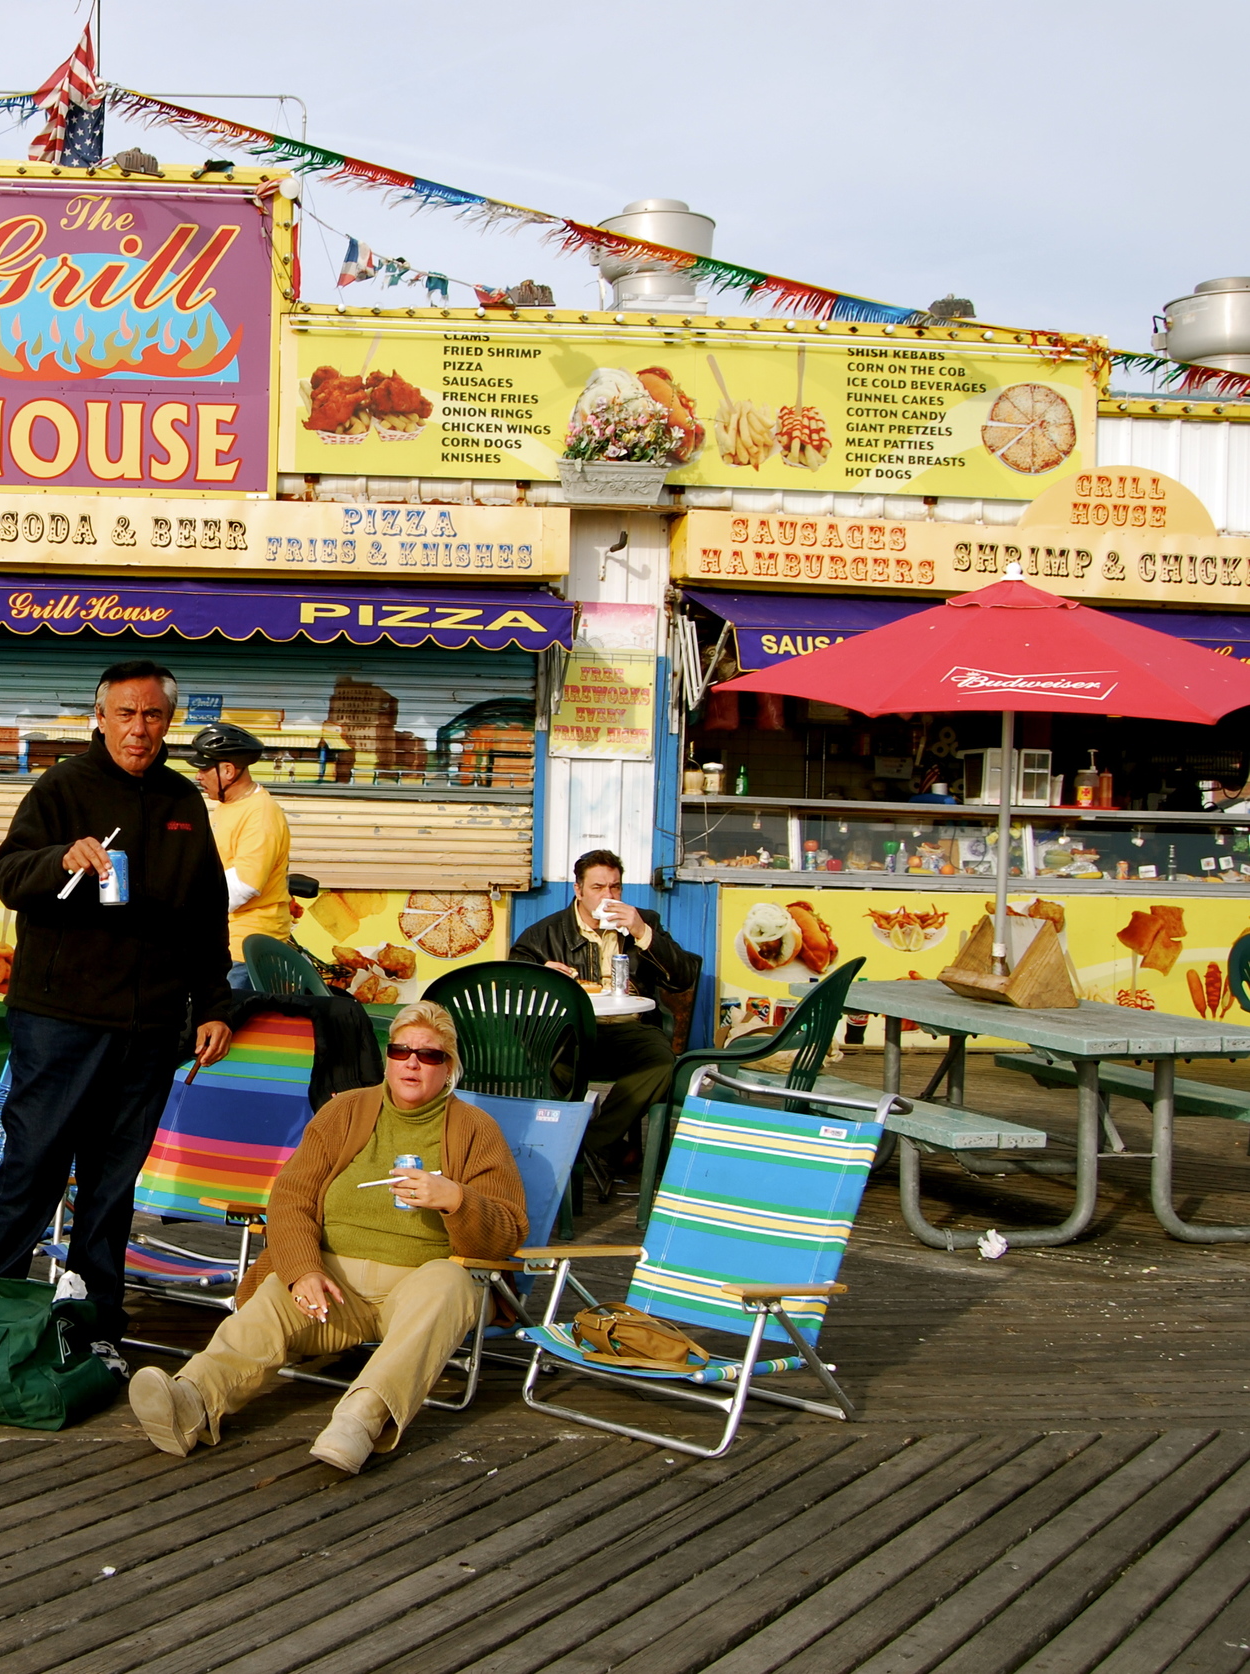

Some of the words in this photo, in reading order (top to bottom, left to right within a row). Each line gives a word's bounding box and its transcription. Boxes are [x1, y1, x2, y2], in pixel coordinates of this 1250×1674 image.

[59, 194, 135, 232] The
[443, 330, 490, 341] CLAMS
[443, 345, 484, 356] FRIED
[487, 347, 542, 359] SHRIMP
[847, 347, 889, 358] SHISH
[893, 349, 945, 361] KEBABS
[443, 361, 483, 372] PIZZA
[847, 362, 884, 373] CORN
[888, 364, 907, 374] ON
[910, 365, 936, 376] THE
[938, 366, 966, 378] COB
[442, 376, 514, 388] SAUSAGES
[847, 377, 868, 388] ICE
[871, 378, 907, 390] COLD
[910, 380, 987, 394] BEVERAGES
[442, 391, 496, 404] FRENCH
[500, 393, 539, 405] FRIES
[846, 392, 899, 405] FUNNEL
[901, 394, 945, 407] CAKES
[442, 406, 487, 418] ONION
[490, 408, 533, 420] RINGS
[846, 407, 898, 419] COTTON
[901, 409, 947, 423] CANDY
[442, 421, 504, 434] CHICKEN
[506, 423, 551, 436] WINGS
[846, 422, 885, 434] GIANT
[888, 424, 953, 437] PRETZELS
[441, 437, 481, 448] CORN
[484, 438, 522, 449] DOGS
[845, 437, 880, 448] MEAT
[883, 439, 934, 451] PATTIES
[441, 452, 501, 464] KNISHES
[845, 452, 904, 465] CHICKEN
[908, 454, 966, 468] BREASTS
[845, 467, 871, 479] HOT
[875, 468, 912, 480] DOGS
[1075, 473, 1166, 500] GRILL
[341, 507, 457, 537] PIZZA
[1069, 502, 1167, 528] HOUSE
[0, 511, 97, 545] SODA
[111, 516, 137, 547] &
[150, 516, 248, 550] BEER
[730, 518, 907, 550] SAUSAGES
[265, 536, 357, 564] FRIES
[366, 540, 388, 566] &
[398, 540, 533, 569] KNISHES
[699, 549, 935, 584] HAMBURGERS
[952, 541, 1093, 578] SHRIMP
[1103, 552, 1125, 580] &
[1138, 552, 1250, 587] CHICK
[8, 592, 80, 619] Grill
[76, 594, 173, 621] House
[299, 602, 548, 633] PIZZA
[761, 634, 844, 656] SAUS
[580, 666, 625, 683] FREE
[951, 675, 1101, 689] Budweiser
[562, 685, 650, 706] IREWORKS
[575, 707, 627, 724] EVERY
[553, 724, 601, 742] FRIDAY
[606, 727, 650, 744] NIGHT
